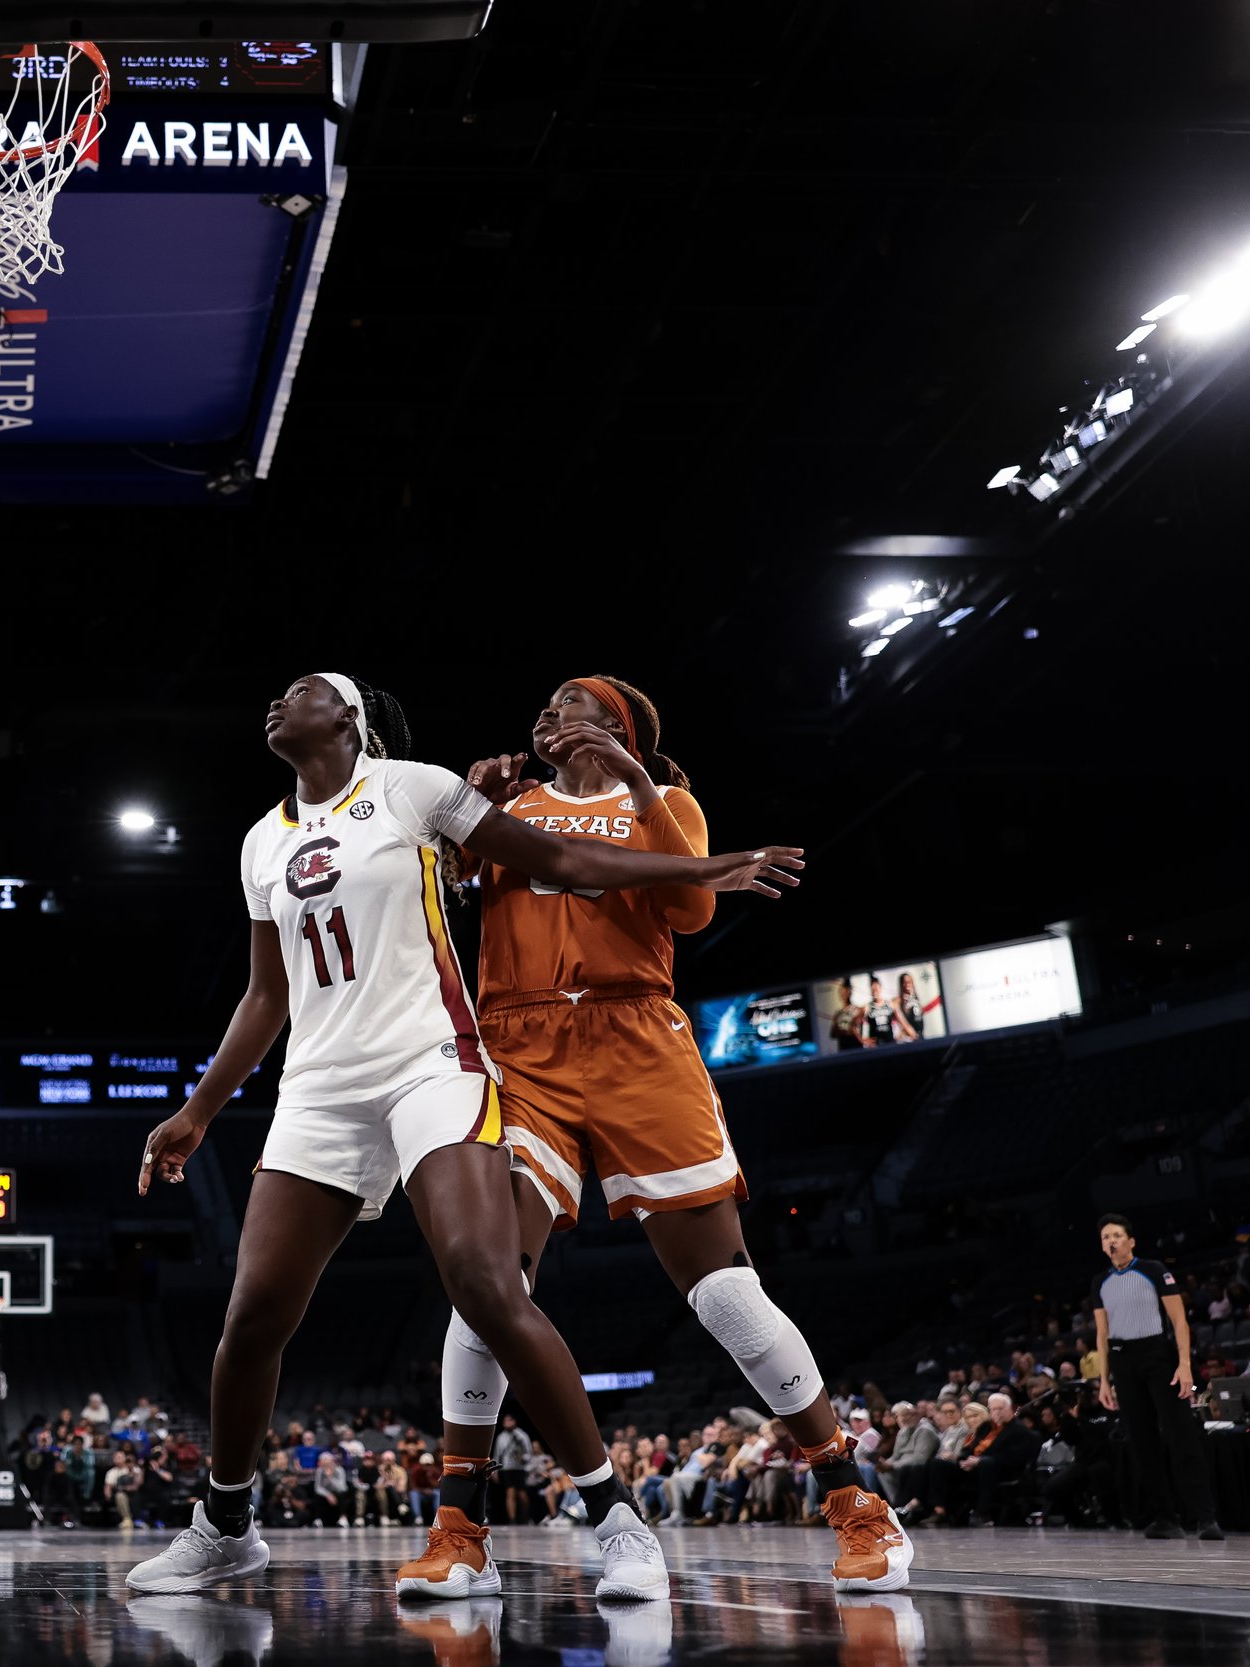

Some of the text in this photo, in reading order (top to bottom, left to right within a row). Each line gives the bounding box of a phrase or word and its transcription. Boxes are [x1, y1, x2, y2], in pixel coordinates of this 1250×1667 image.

[122, 120, 313, 165] ARENA
[350, 801, 374, 819] SEC
[524, 815, 633, 839] TEXAS
[301, 904, 357, 989] 11
